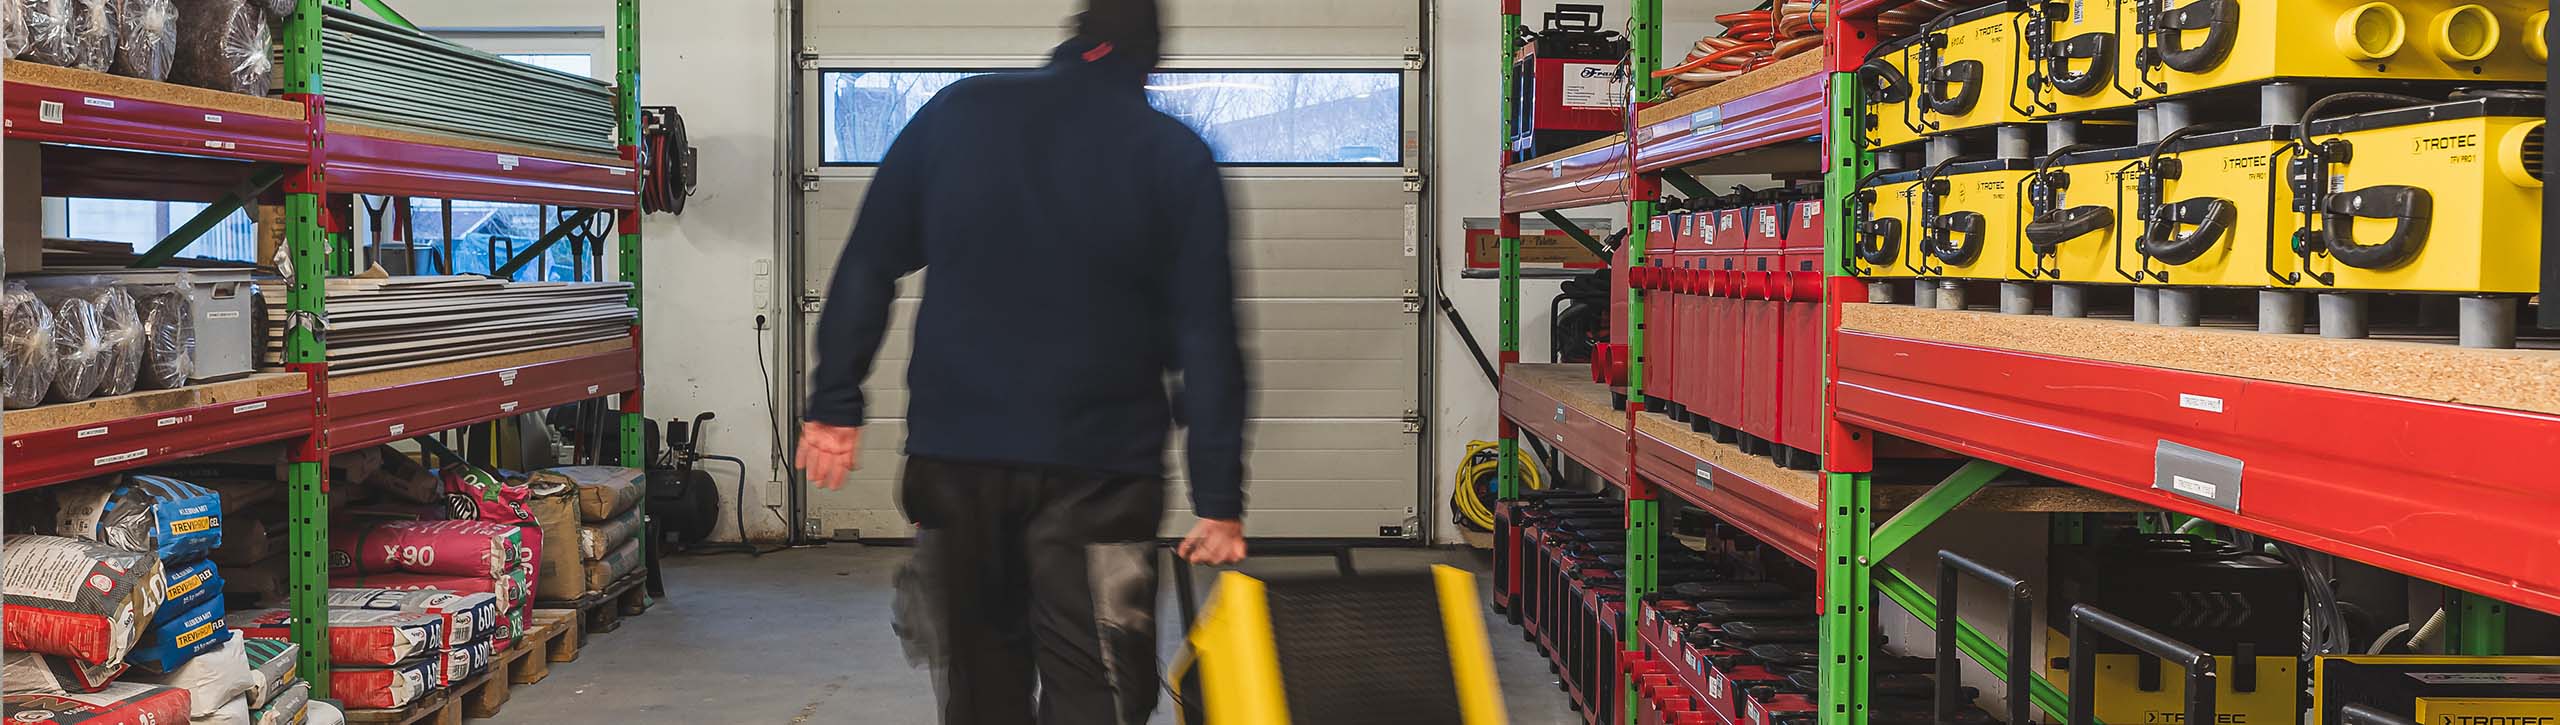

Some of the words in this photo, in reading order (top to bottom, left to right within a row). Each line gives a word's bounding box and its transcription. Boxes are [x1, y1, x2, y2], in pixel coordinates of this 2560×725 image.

[1979, 23, 2003, 36] TROTEC
[2423, 134, 2477, 151] TROTEC
[2229, 155, 2267, 169] TROTEC
[1980, 180, 2005, 192] TROTEC
[199, 568, 214, 582] FLEX
[478, 602, 496, 632] 600
[212, 618, 226, 631] FLEX
[474, 641, 490, 669] 600
